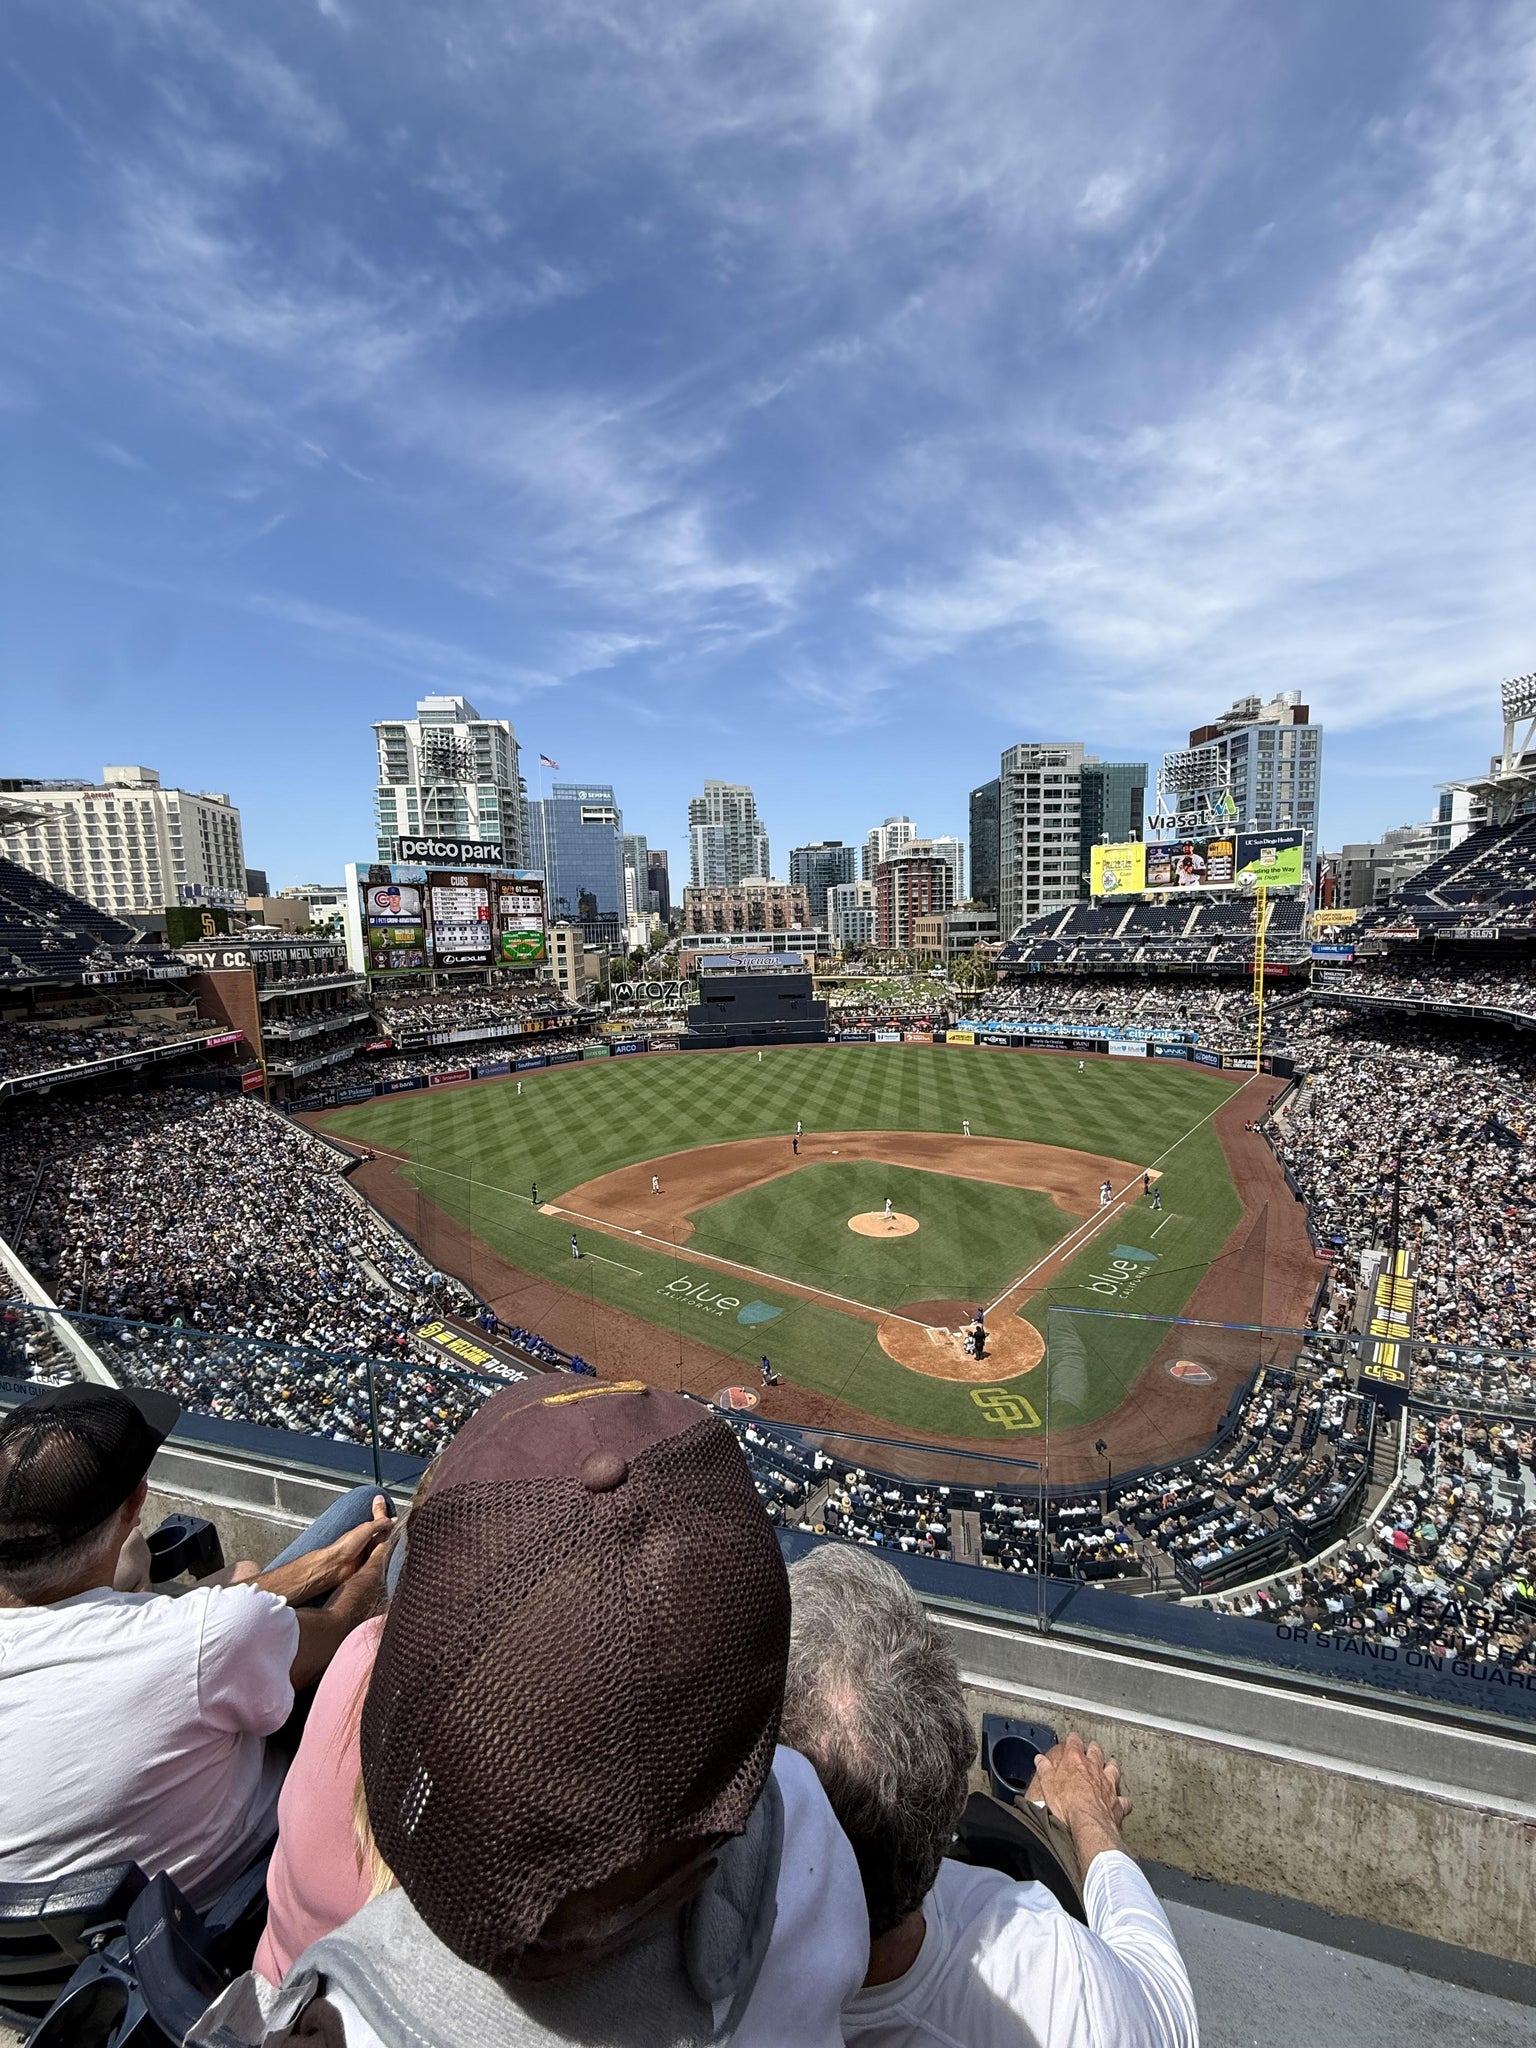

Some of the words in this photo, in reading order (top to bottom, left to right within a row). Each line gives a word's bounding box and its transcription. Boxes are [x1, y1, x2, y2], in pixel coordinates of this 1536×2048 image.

[1148, 811, 1208, 830] Viasat
[402, 839, 459, 859] petco
[461, 844, 501, 861] park
[450, 876, 469, 886] CUBS
[222, 952, 251, 967] CO.
[251, 951, 287, 963] WESTERN
[290, 949, 312, 960] METAL
[313, 948, 335, 958] SUPPLY
[337, 947, 347, 957] CO.
[728, 952, 781, 970] Sycuan
[636, 981, 690, 999] razr
[616, 1044, 636, 1053] ARCO
[651, 1041, 676, 1050] Sycuan
[1202, 1053, 1217, 1062] petco
[324, 1096, 336, 1104] 342
[347, 1086, 373, 1096] Palomar
[1088, 1260, 1138, 1296] blue
[1119, 1266, 1152, 1299] CALIFORNIA
[665, 1275, 740, 1310] blue
[656, 1288, 723, 1317] CALIFORNIA
[445, 1337, 494, 1366] WELCOME
[1371, 1587, 1516, 1634] PLEASE
[1332, 1611, 1365, 1630] DO
[1374, 1620, 1423, 1641] NOT
[1276, 1624, 1308, 1644] OR
[1316, 1633, 1398, 1661] STAND
[1406, 1651, 1443, 1672] ON
